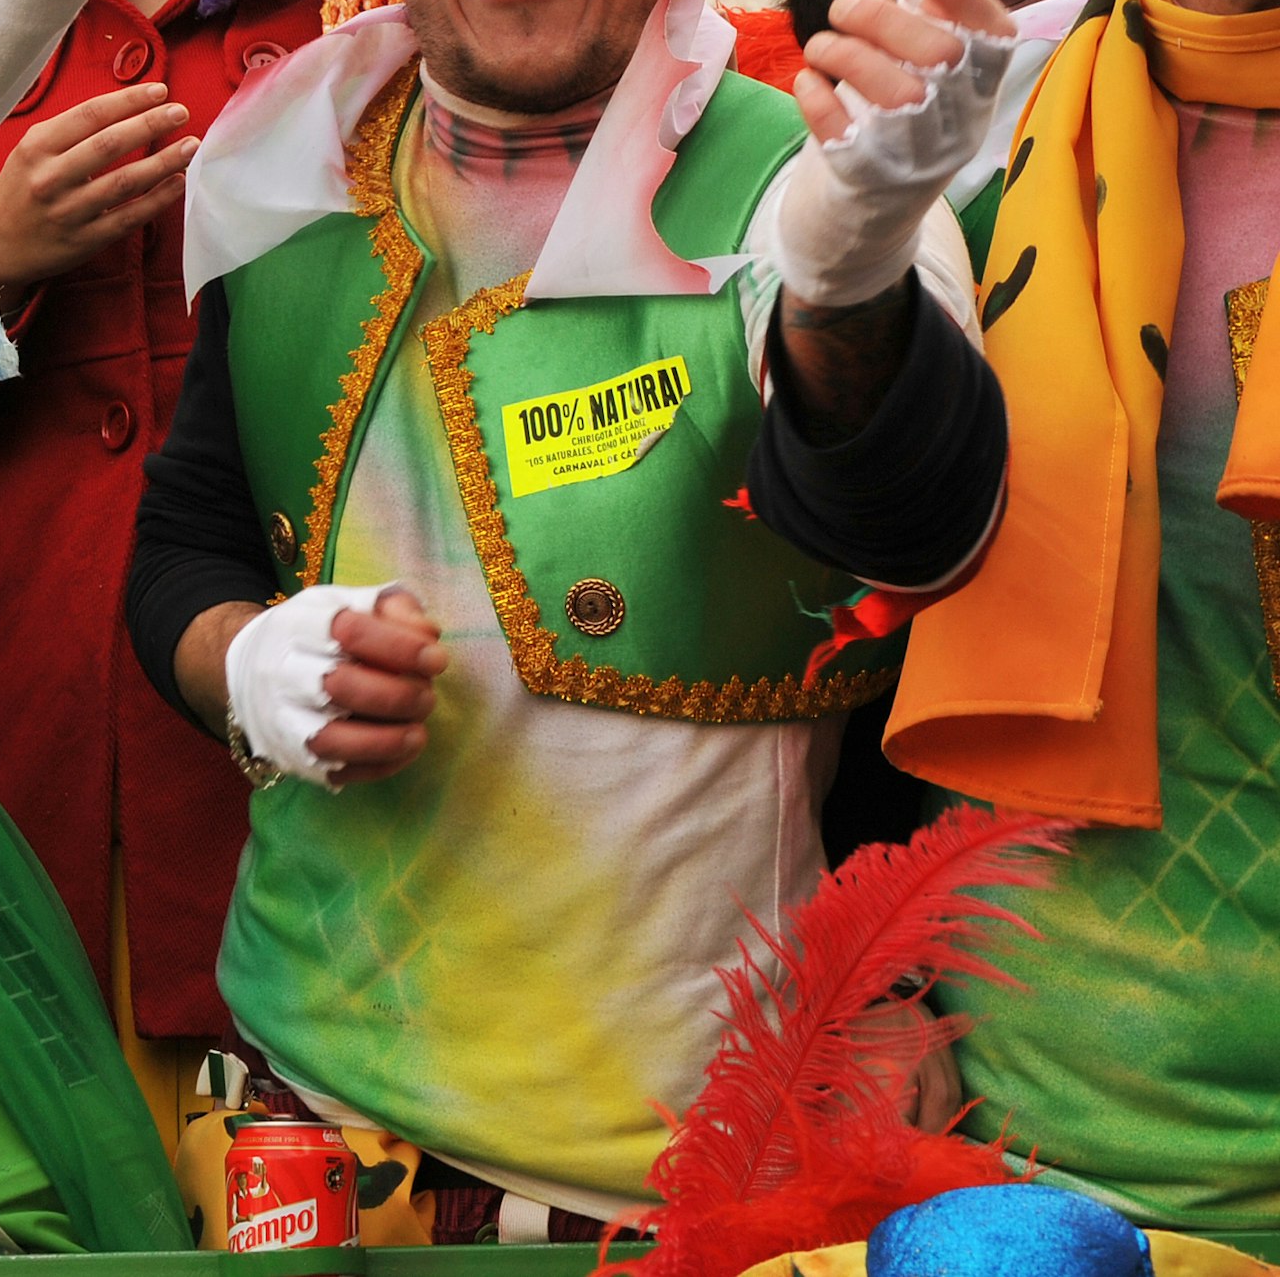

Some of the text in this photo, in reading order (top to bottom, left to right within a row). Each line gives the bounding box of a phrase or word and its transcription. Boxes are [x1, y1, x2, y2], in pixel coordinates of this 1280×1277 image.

[519, 398, 585, 445] 100%
[571, 418, 647, 446] CHIRIGOTA DE CÁDIZ
[596, 439, 617, 453] COMO
[619, 436, 629, 445] MI
[553, 458, 605, 475] CARNAVAL
[607, 454, 618, 464] DE
